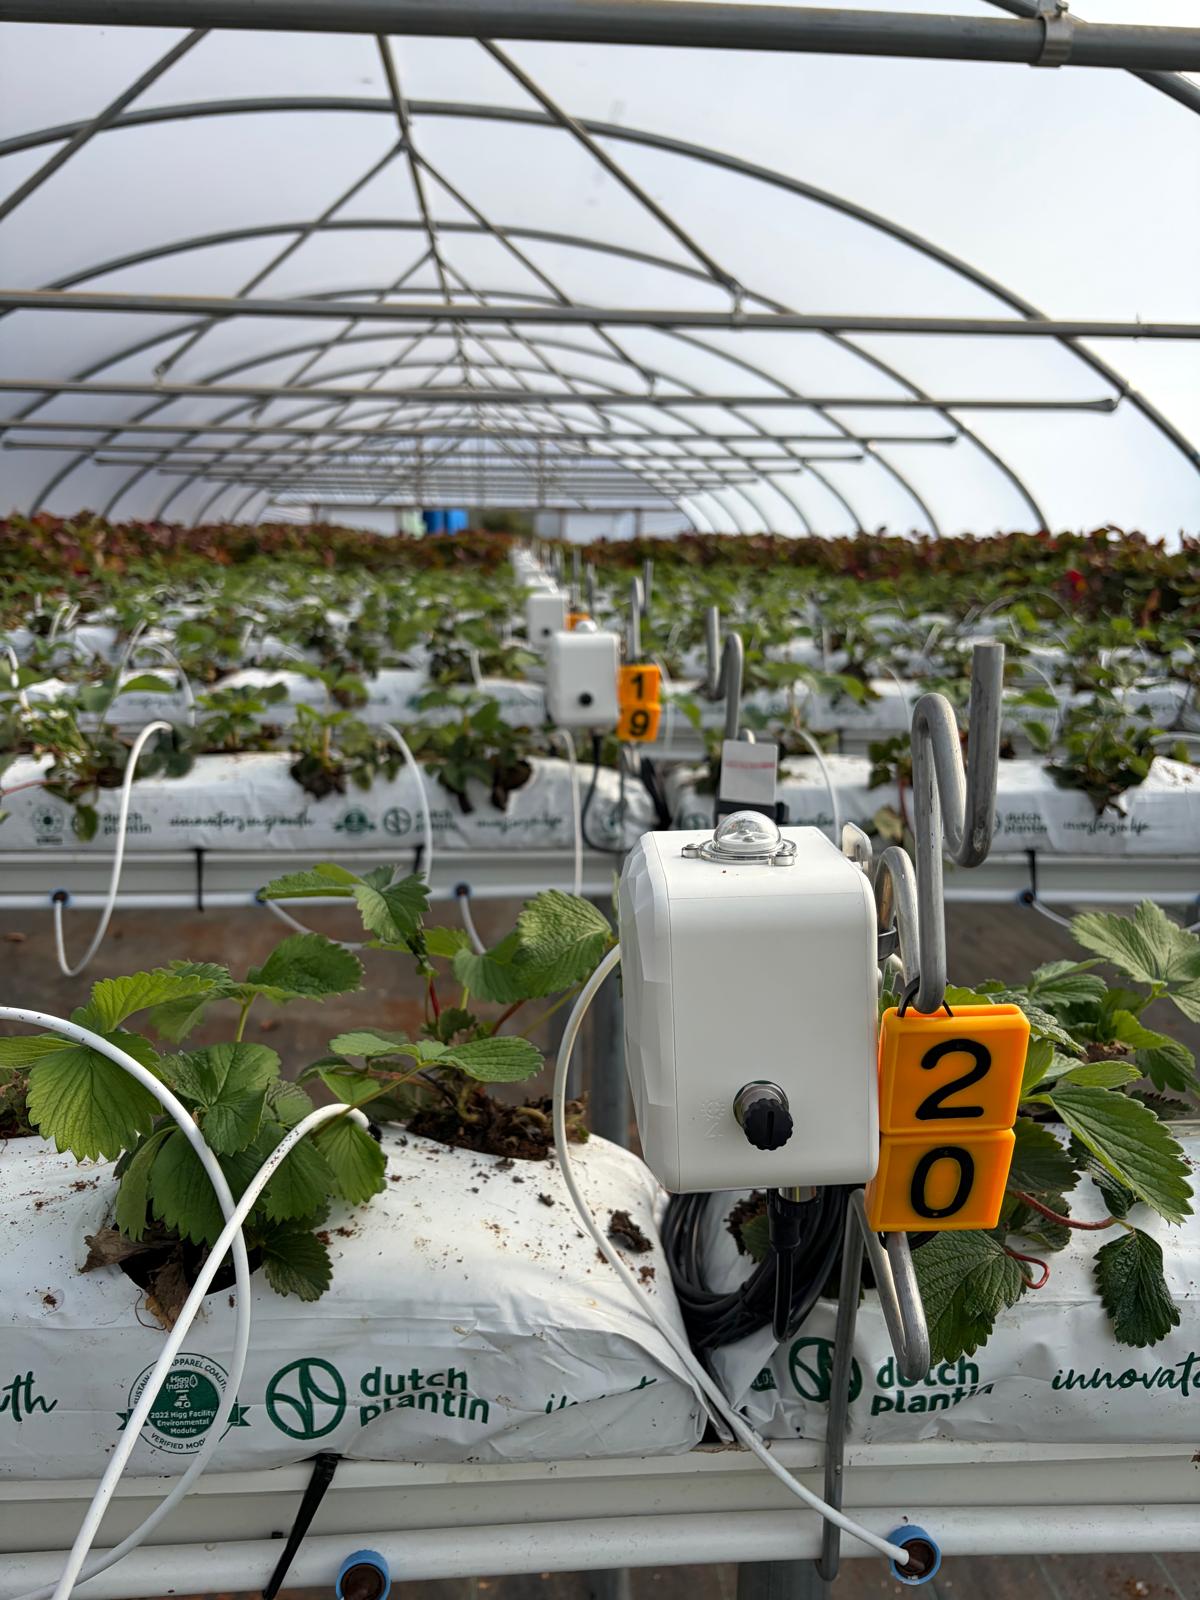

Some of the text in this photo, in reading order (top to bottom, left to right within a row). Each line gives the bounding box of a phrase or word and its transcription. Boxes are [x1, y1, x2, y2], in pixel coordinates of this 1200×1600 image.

[631, 672, 644, 700] 1
[629, 709, 650, 737] 9
[915, 1038, 992, 1121] 2
[911, 1146, 975, 1219] 0
[360, 1366, 467, 1398] dutch
[150, 1409, 216, 1420] 2022 Higg Facility
[360, 1389, 490, 1427] plantin
[156, 1418, 210, 1427] Environmental
[151, 1432, 184, 1450] VERIFIED
